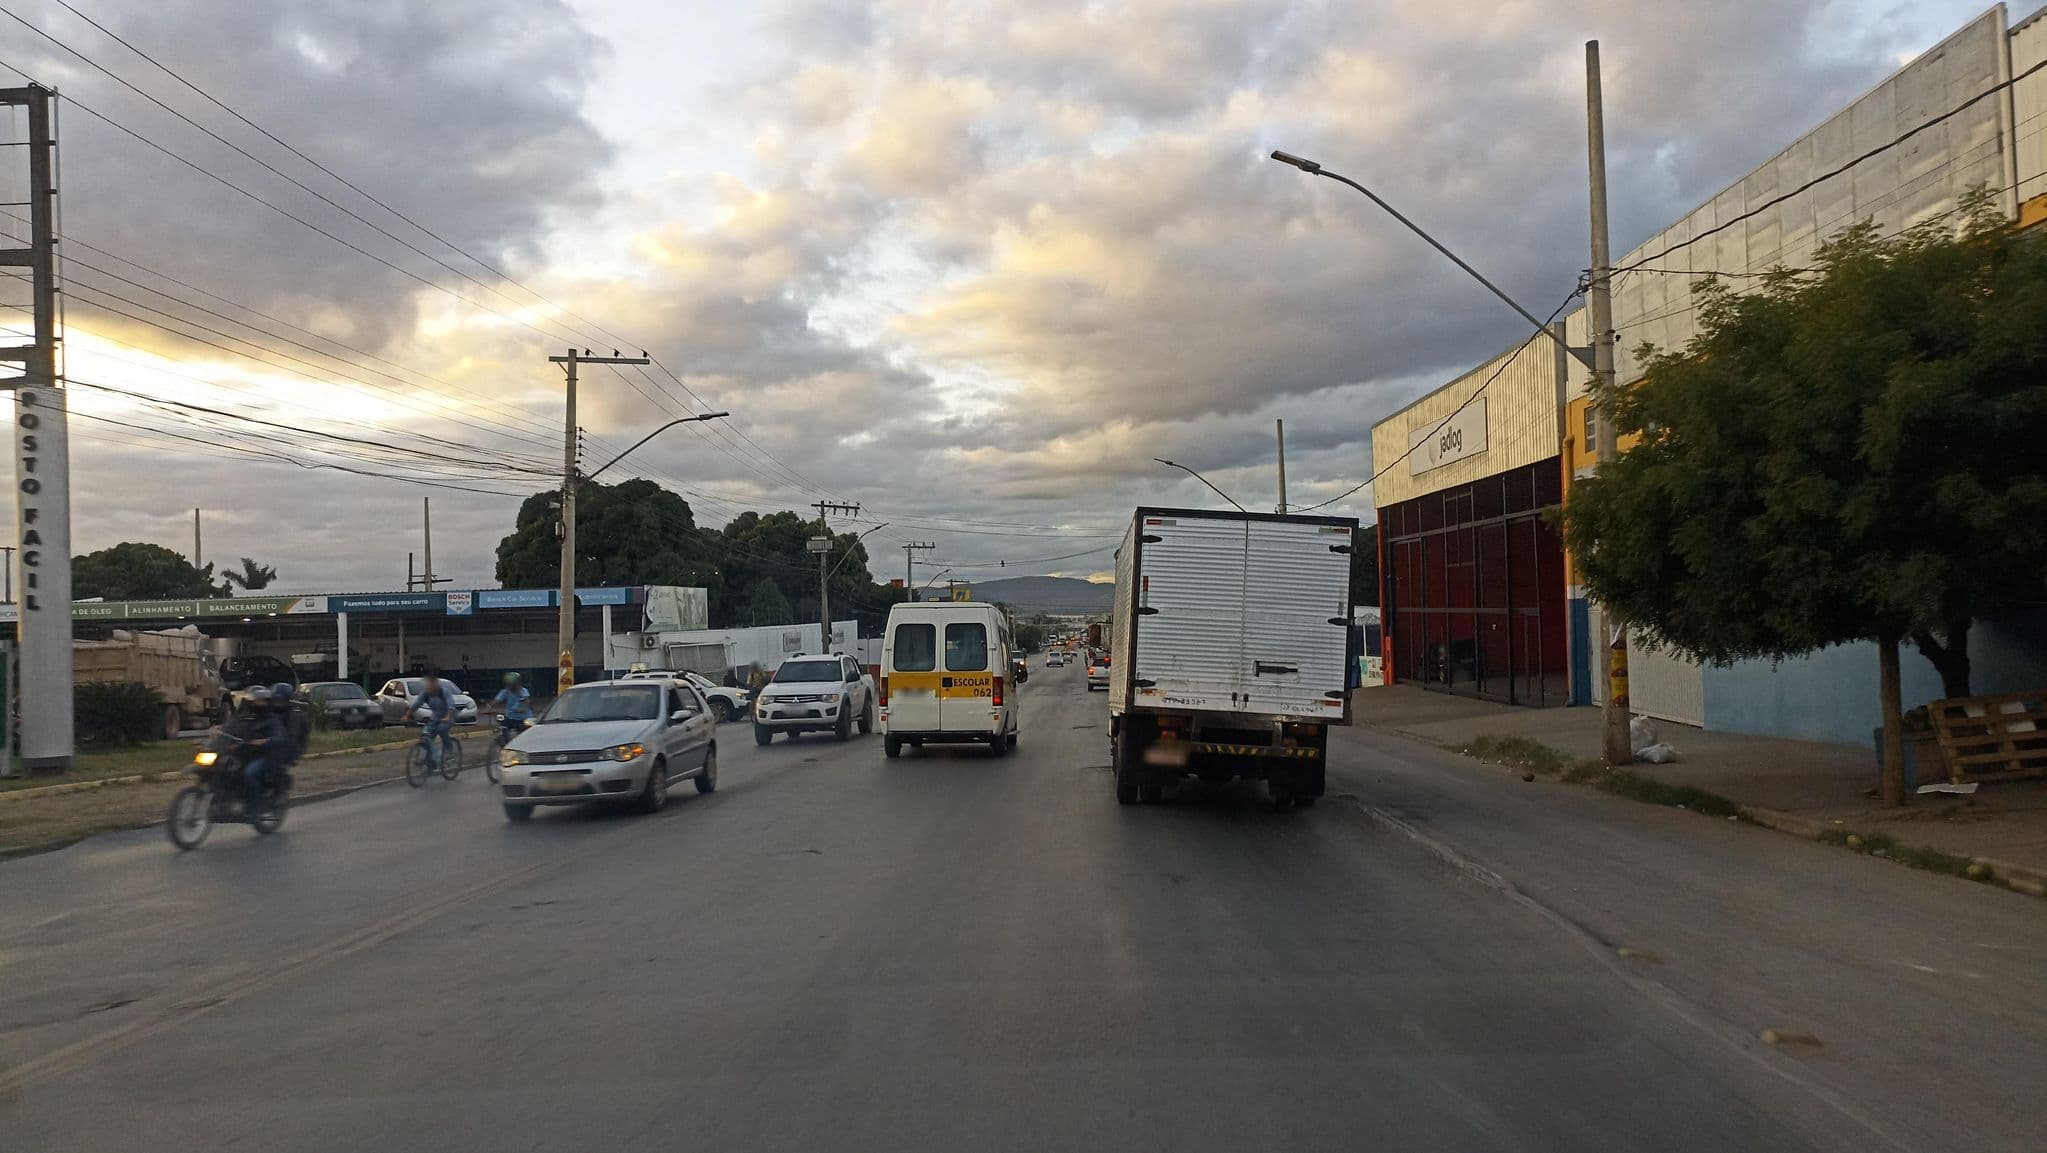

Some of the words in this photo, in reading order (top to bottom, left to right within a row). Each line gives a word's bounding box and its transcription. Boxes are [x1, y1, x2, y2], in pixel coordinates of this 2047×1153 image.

[20, 391, 41, 495] POSTO
[1440, 426, 1462, 459] jadlog
[132, 606, 191, 614] ALINHAMENTO
[209, 603, 278, 612] BALANCEAMENTO
[953, 678, 990, 687] ESCOLAR
[973, 688, 992, 697] 062
